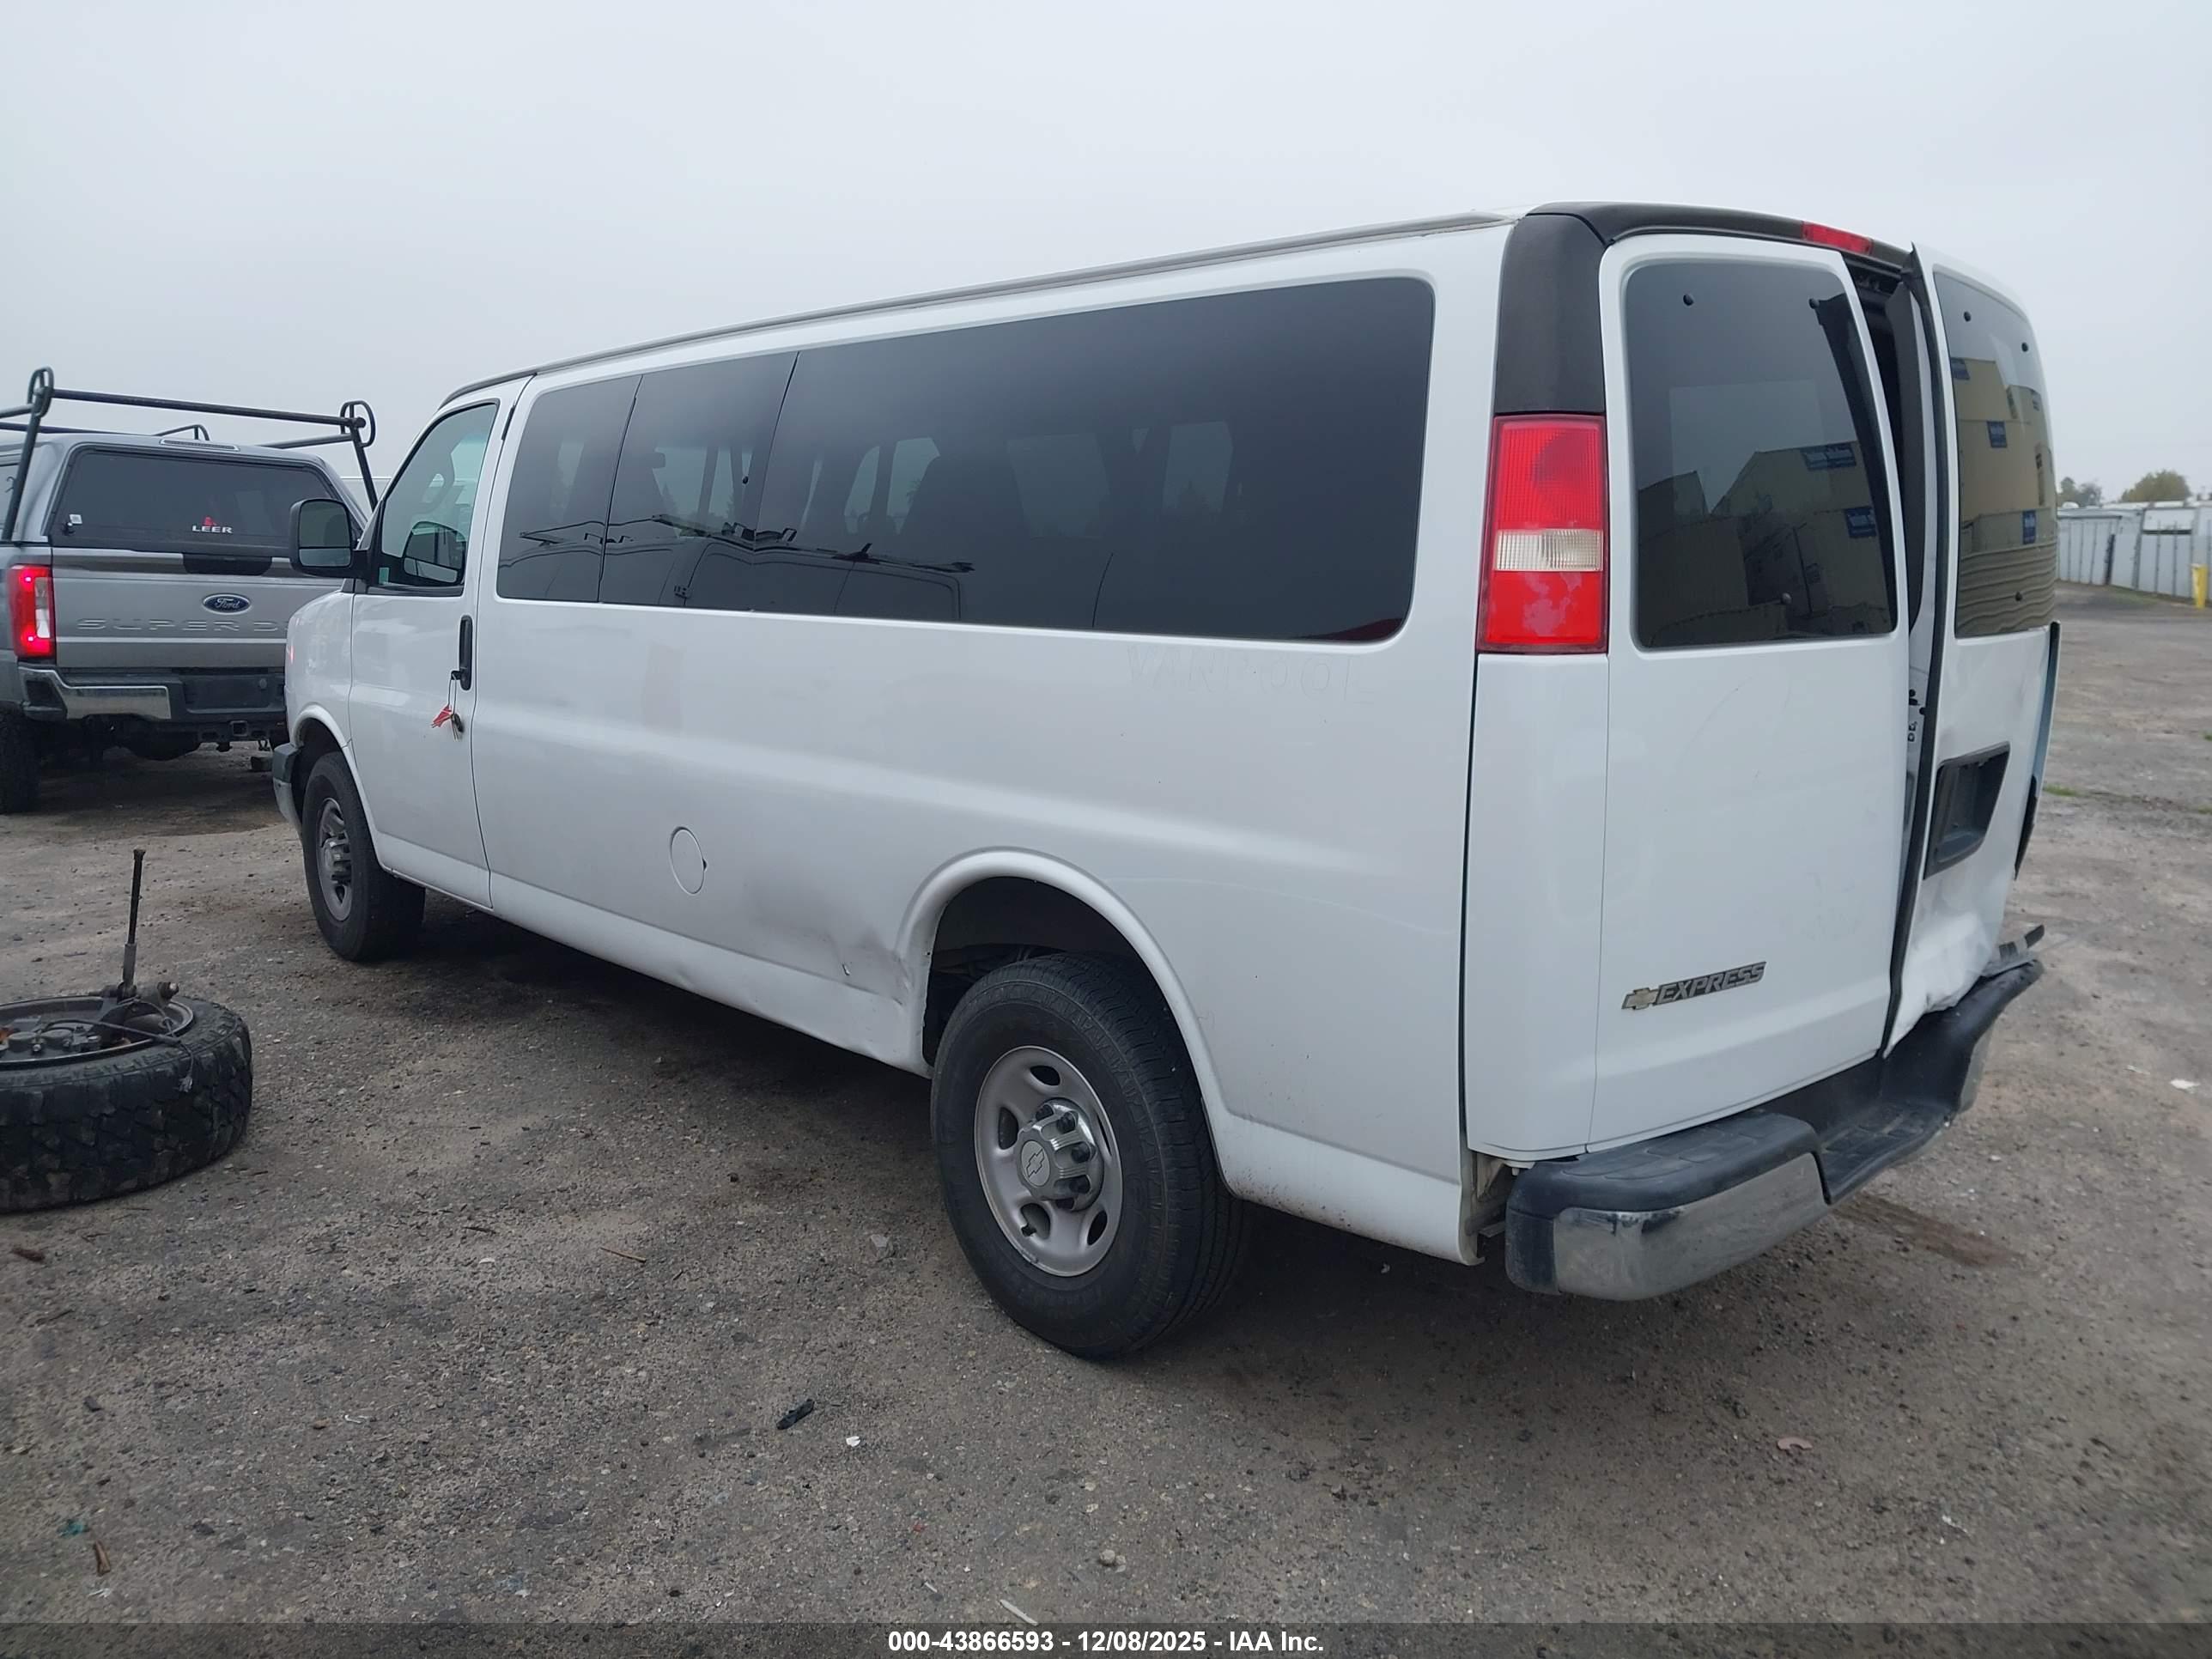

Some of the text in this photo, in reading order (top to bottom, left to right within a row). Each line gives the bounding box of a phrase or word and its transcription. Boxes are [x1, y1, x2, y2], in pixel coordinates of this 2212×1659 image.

[191, 524, 234, 534] LEER
[214, 596, 241, 611] Ford
[76, 618, 240, 633] SUPER
[1657, 963, 1765, 1006] EXPRESS
